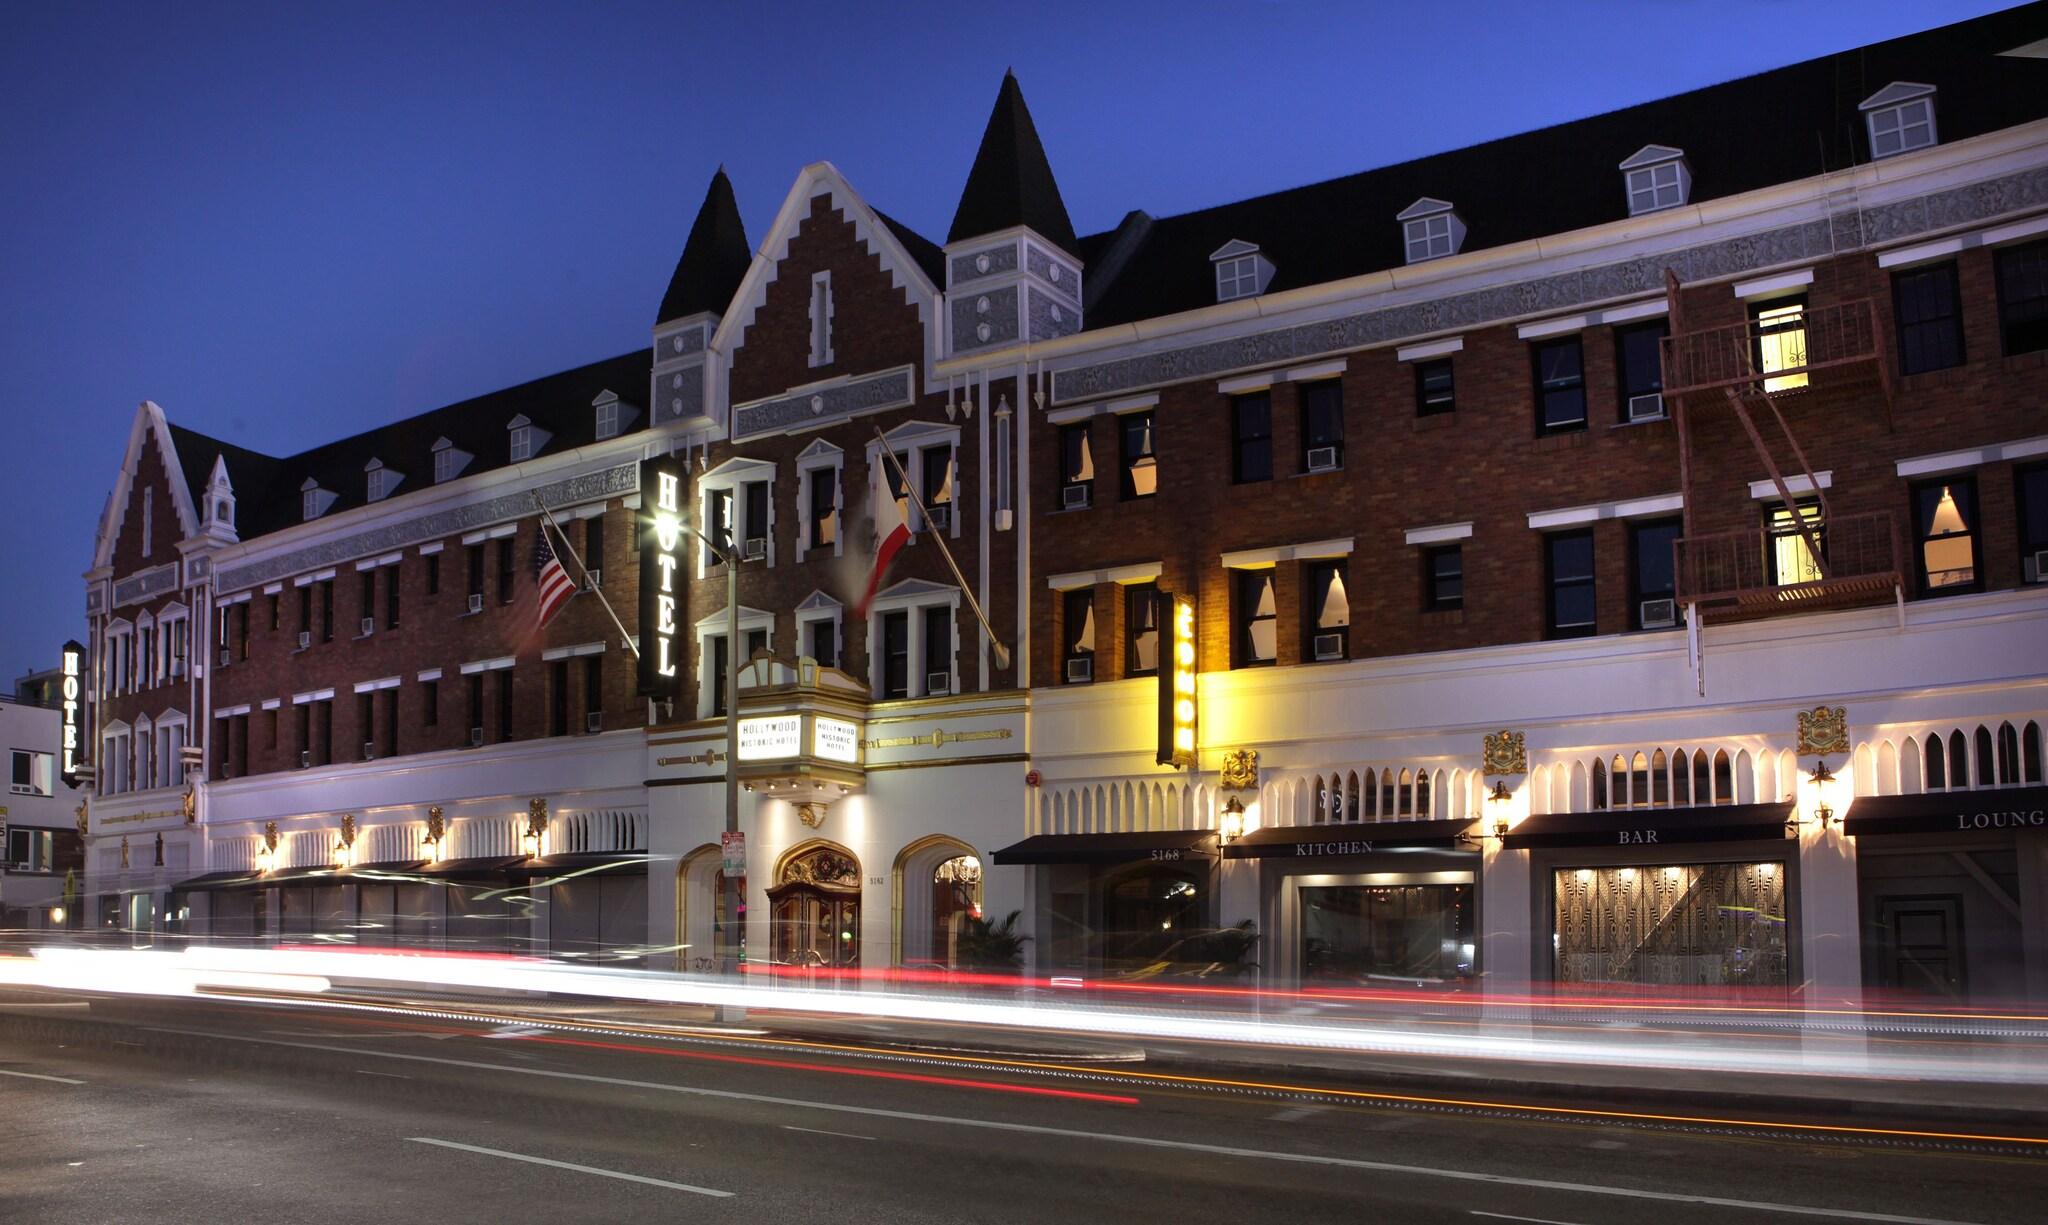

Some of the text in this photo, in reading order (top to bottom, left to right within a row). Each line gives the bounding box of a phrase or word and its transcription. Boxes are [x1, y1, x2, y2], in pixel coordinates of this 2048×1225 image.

[658, 471, 679, 678] HOTEL
[64, 652, 78, 773] HOTEL
[743, 721, 797, 735] HOLLYWOOD
[817, 723, 855, 735] HOLLYWOOD
[741, 736, 797, 748] HISTORIC HOTEL
[821, 733, 851, 744] HISTORIC
[827, 743, 844, 751] HOTEL
[1957, 810, 2046, 829] LOUNG
[1619, 830, 1659, 844] BAR
[1151, 849, 1180, 861] 5168
[1296, 841, 1373, 856] KITCHEN
